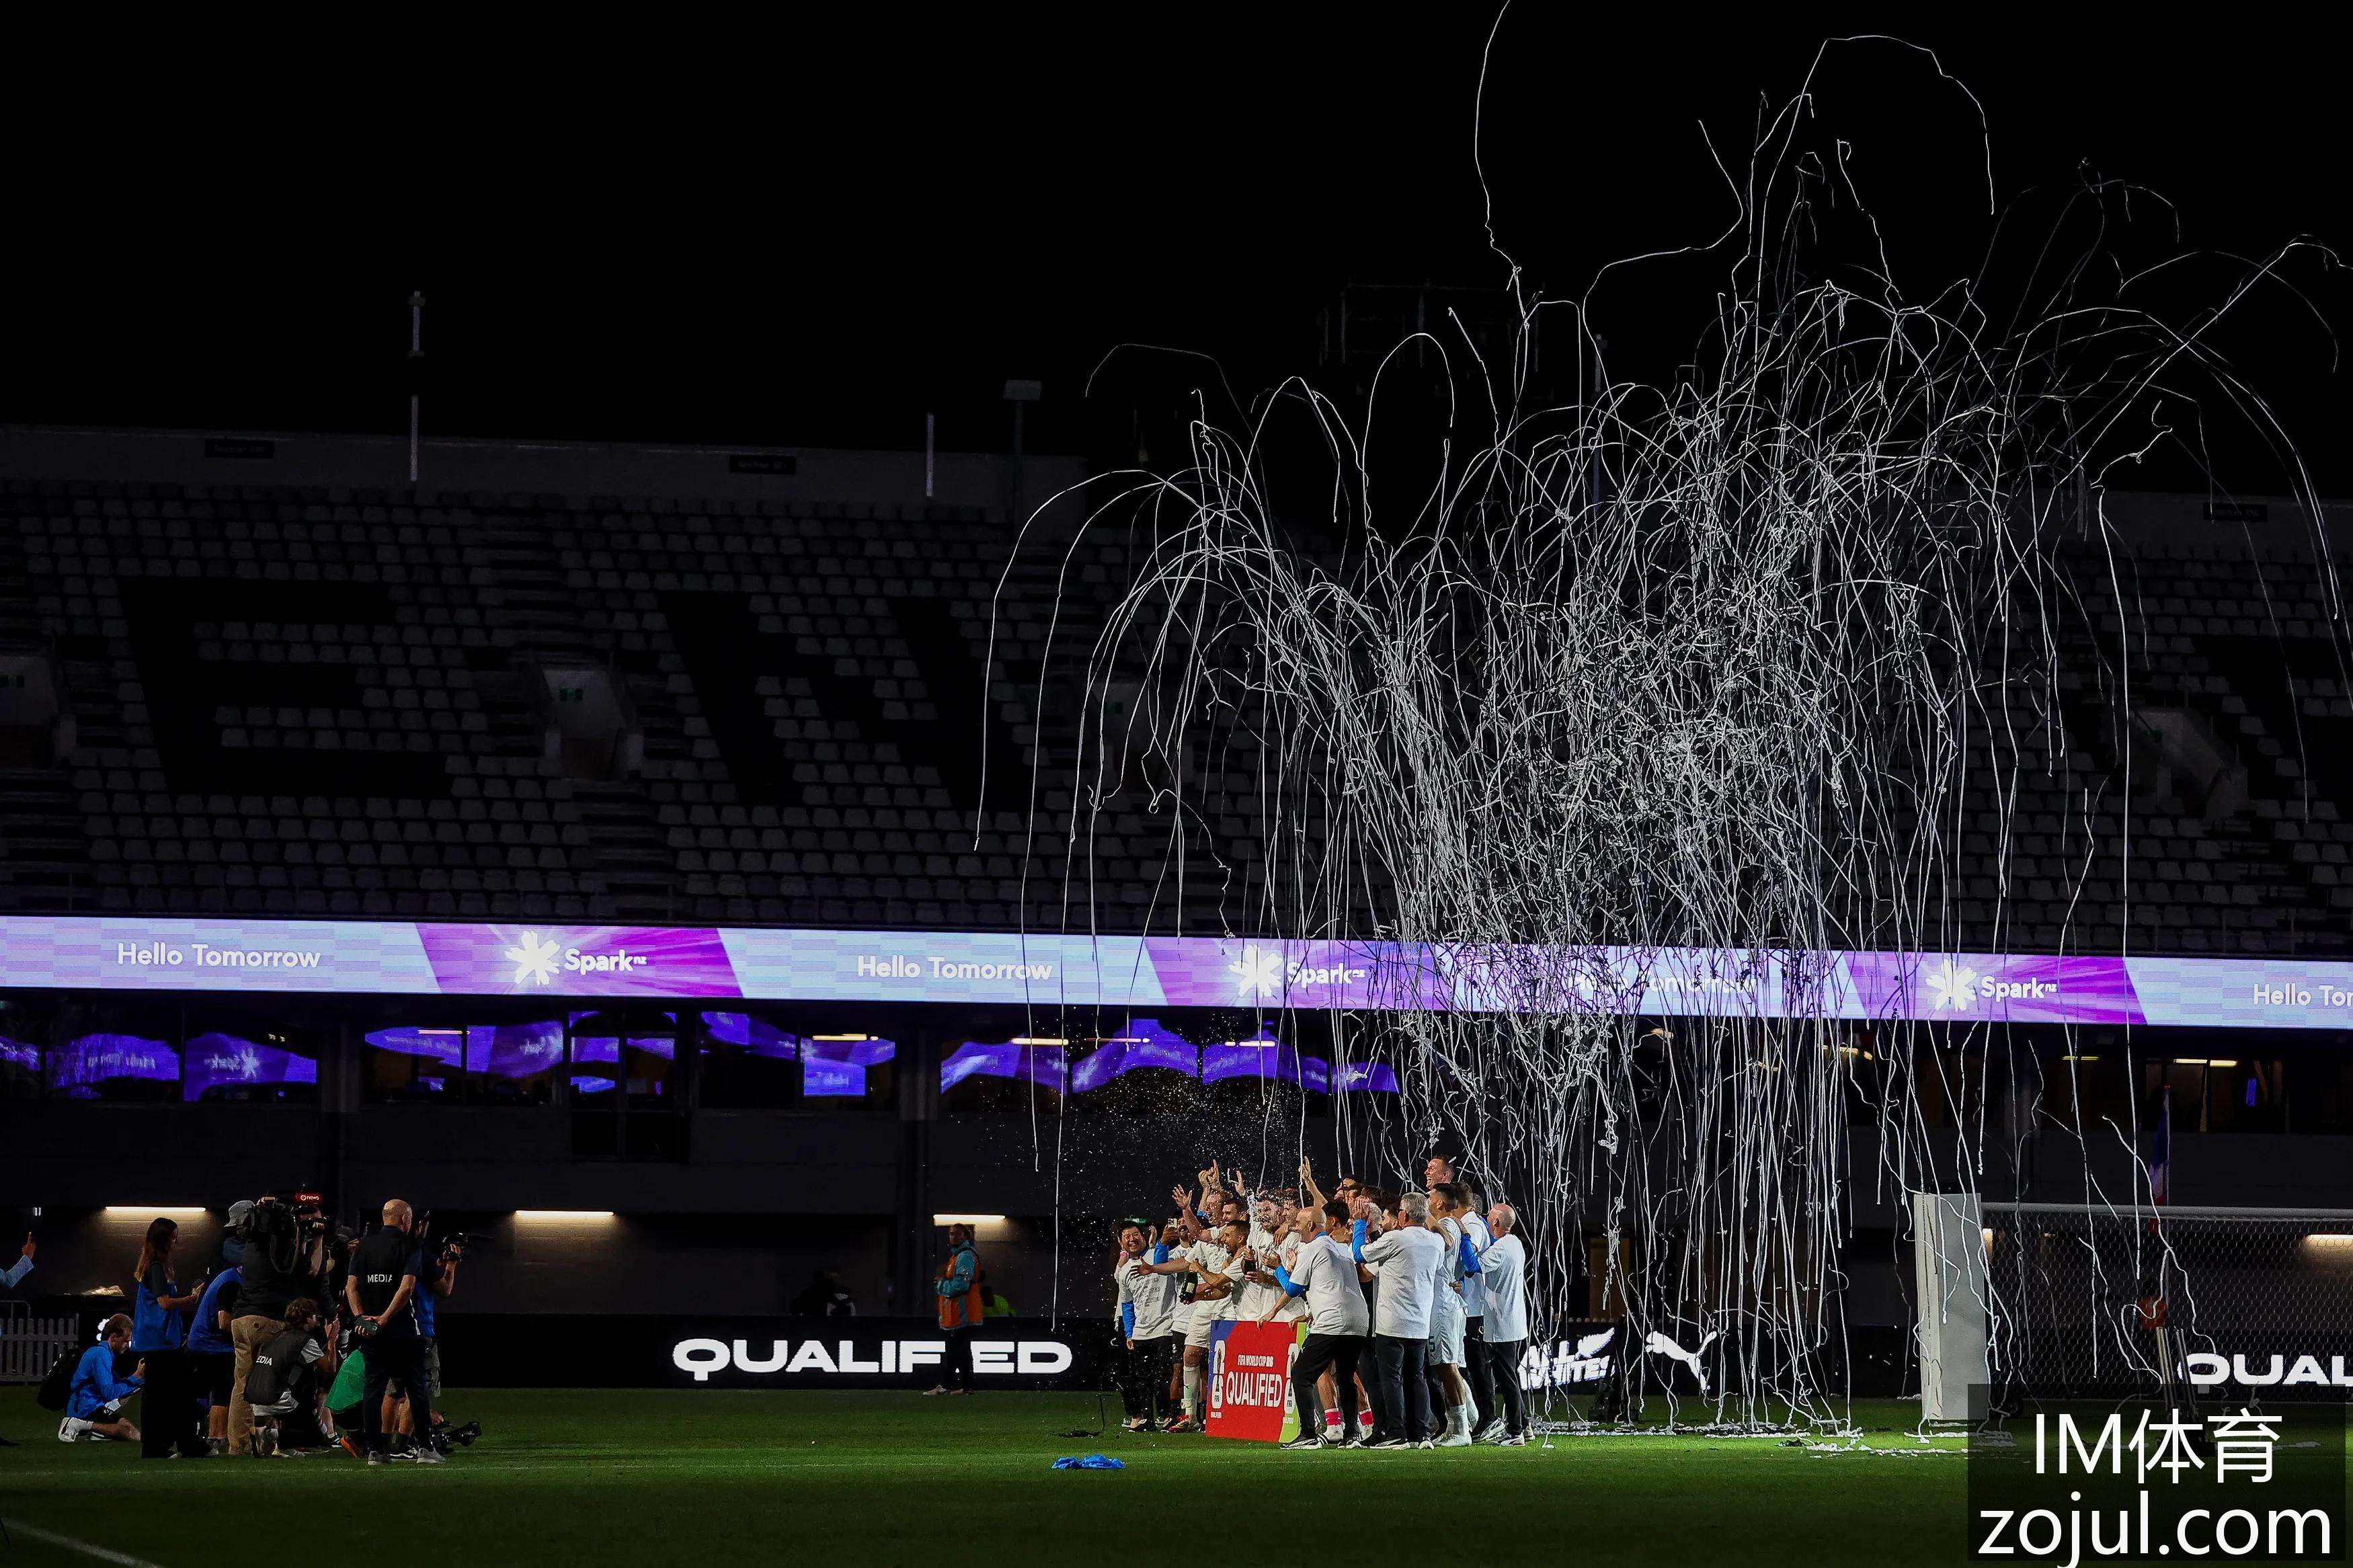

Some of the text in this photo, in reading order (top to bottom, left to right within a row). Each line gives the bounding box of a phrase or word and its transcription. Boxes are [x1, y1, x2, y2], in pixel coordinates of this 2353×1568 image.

[118, 942, 321, 968] Hello Tomorrow
[564, 948, 633, 975] Spark
[857, 954, 1053, 980] Hello Tomorrow
[1981, 975, 2045, 1002] Spark
[2254, 983, 2311, 1006] Hello
[367, 1274, 393, 1284] MEDIA
[672, 1338, 1073, 1382] QUALIFED
[1226, 1370, 1283, 1408] QUALIFIED
